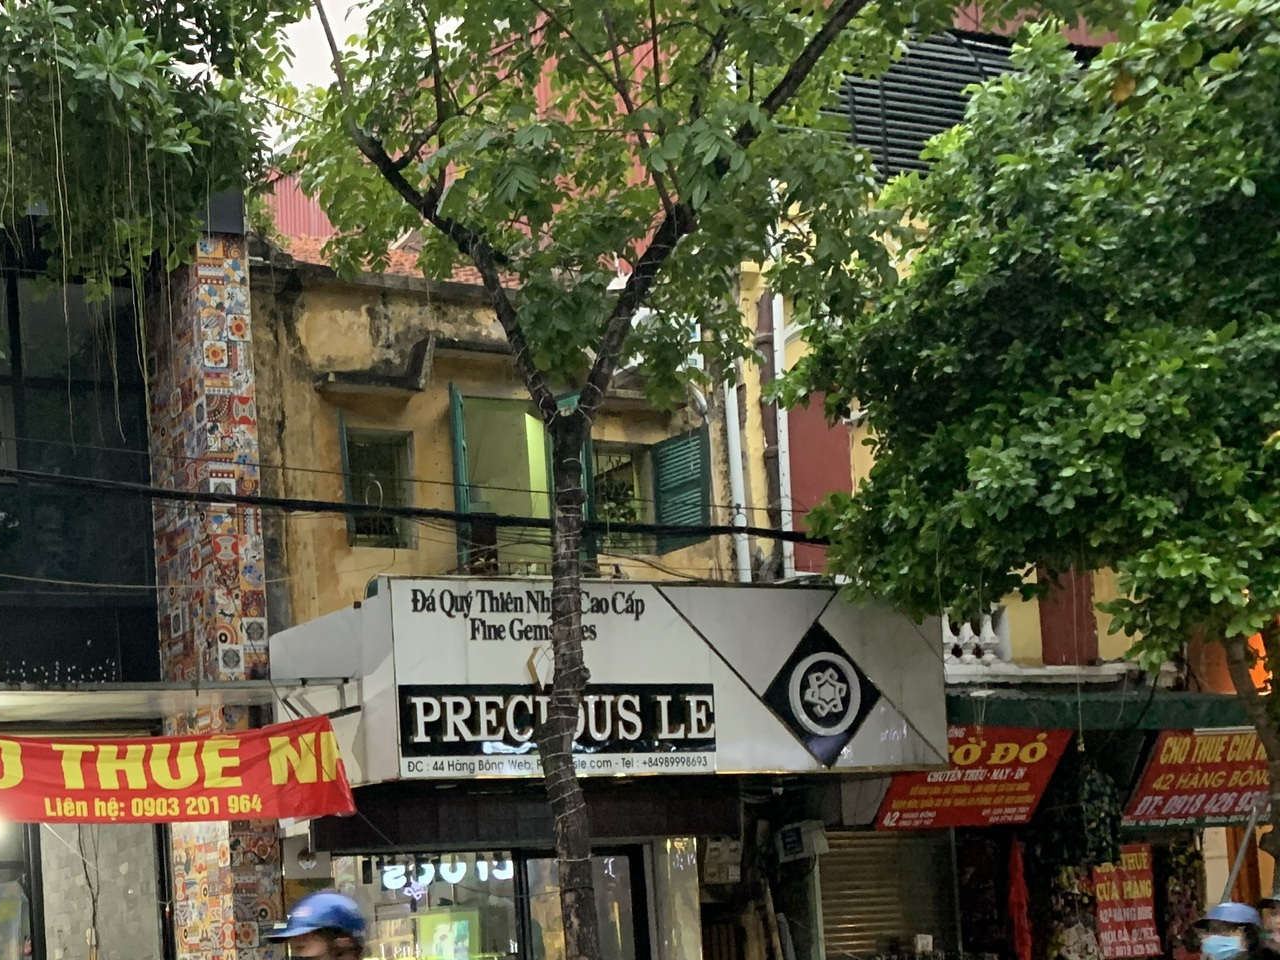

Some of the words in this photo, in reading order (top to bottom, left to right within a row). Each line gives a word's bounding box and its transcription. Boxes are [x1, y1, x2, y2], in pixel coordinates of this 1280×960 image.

[411, 589, 436, 612] Đá
[439, 590, 472, 618] Quý
[476, 590, 524, 614] Thiên
[579, 592, 609, 614] Cao
[612, 590, 645, 621] Cấp
[658, 694, 715, 739] LE
[52, 736, 244, 789] THUÊ
[1160, 736, 1191, 765] CHO
[432, 761, 445, 772] 44
[448, 759, 475, 774] Hàng
[478, 759, 504, 773] Bông
[642, 756, 708, 768] +84989998693
[1152, 773, 1175, 791] 42
[1175, 766, 1226, 789] HÀNG
[44, 797, 94, 817] Liên
[99, 797, 125, 822] hệ:
[131, 796, 180, 817] 0903
[185, 796, 220, 815] 201
[227, 795, 262, 814] 964
[883, 811, 900, 827] 42
